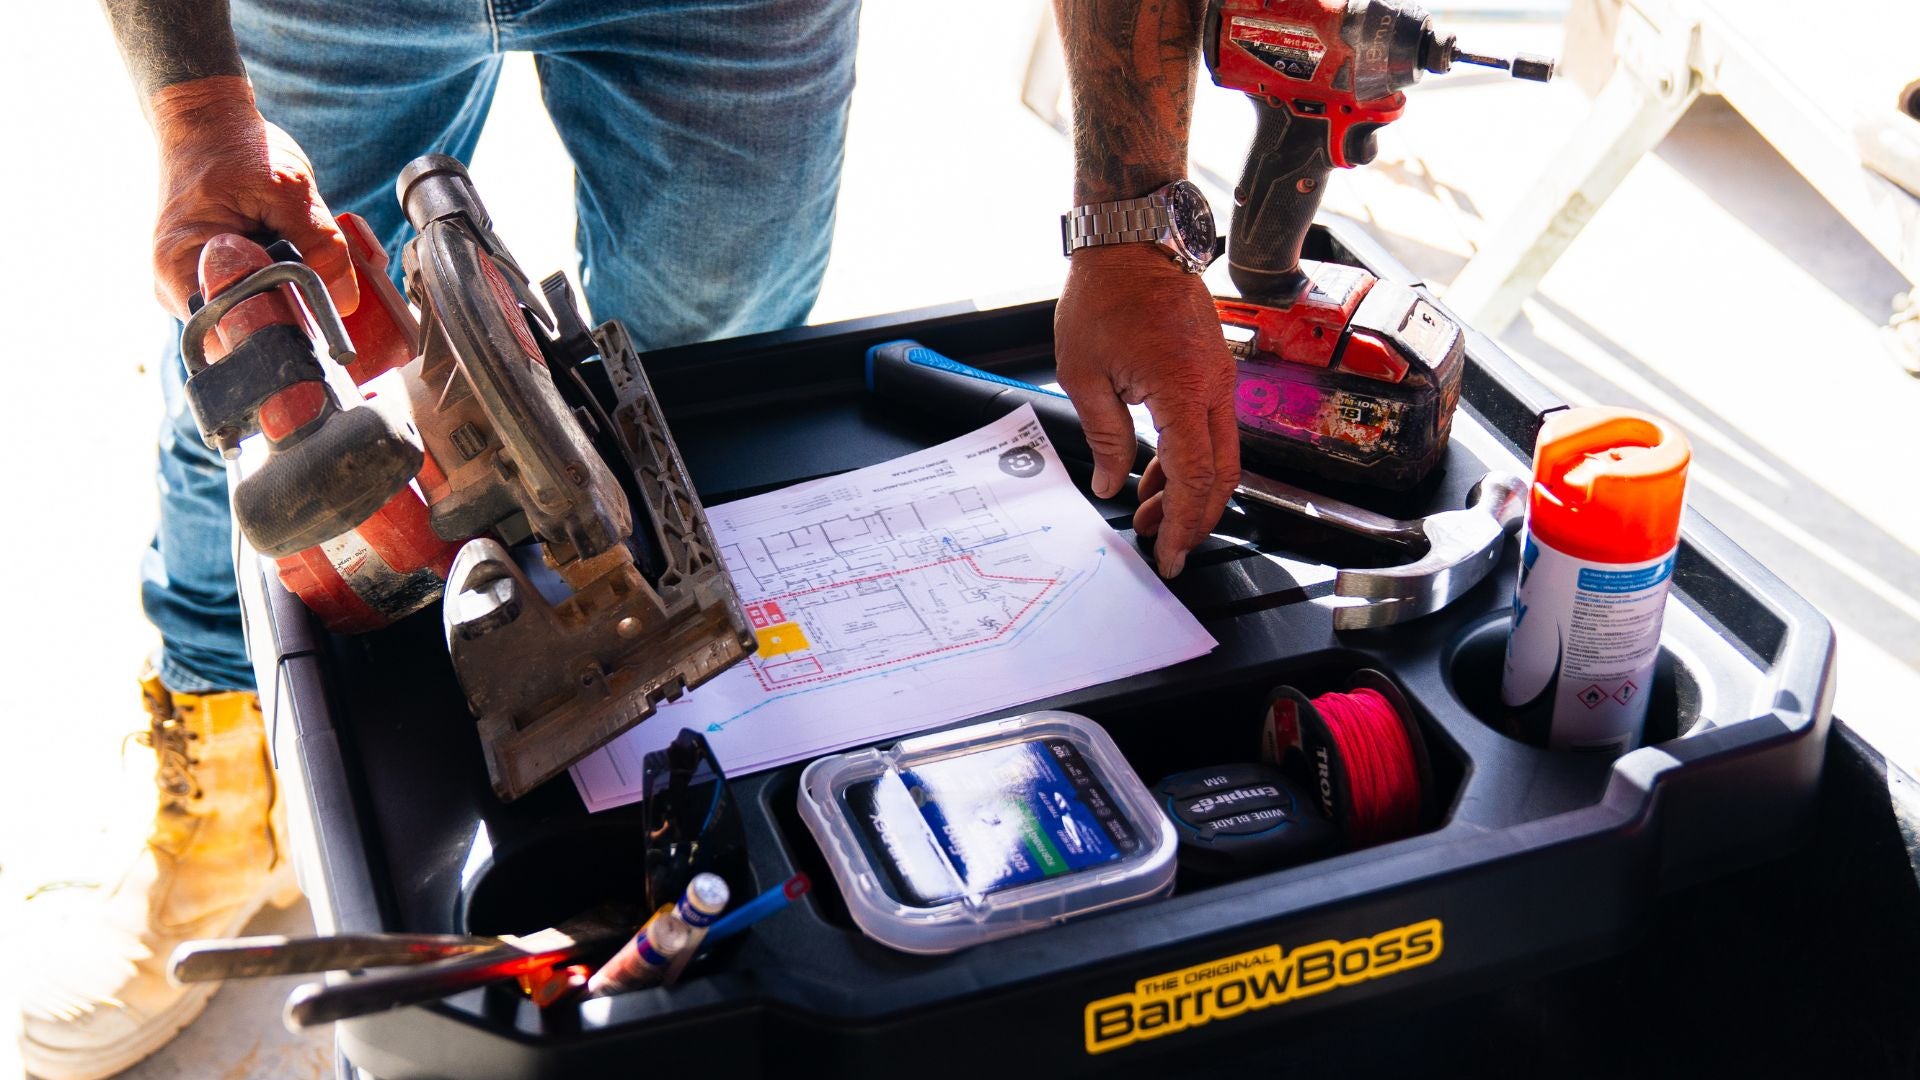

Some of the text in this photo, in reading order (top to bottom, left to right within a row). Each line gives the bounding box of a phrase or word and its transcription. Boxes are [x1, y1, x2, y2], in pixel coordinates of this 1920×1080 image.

[1202, 775, 1229, 788] 8M
[1196, 785, 1280, 809] Empire
[1210, 807, 1286, 830] WIDE BLADE
[1092, 926, 1435, 1045] BarrowBoss
[1141, 952, 1275, 996] THE ORIGINAL
